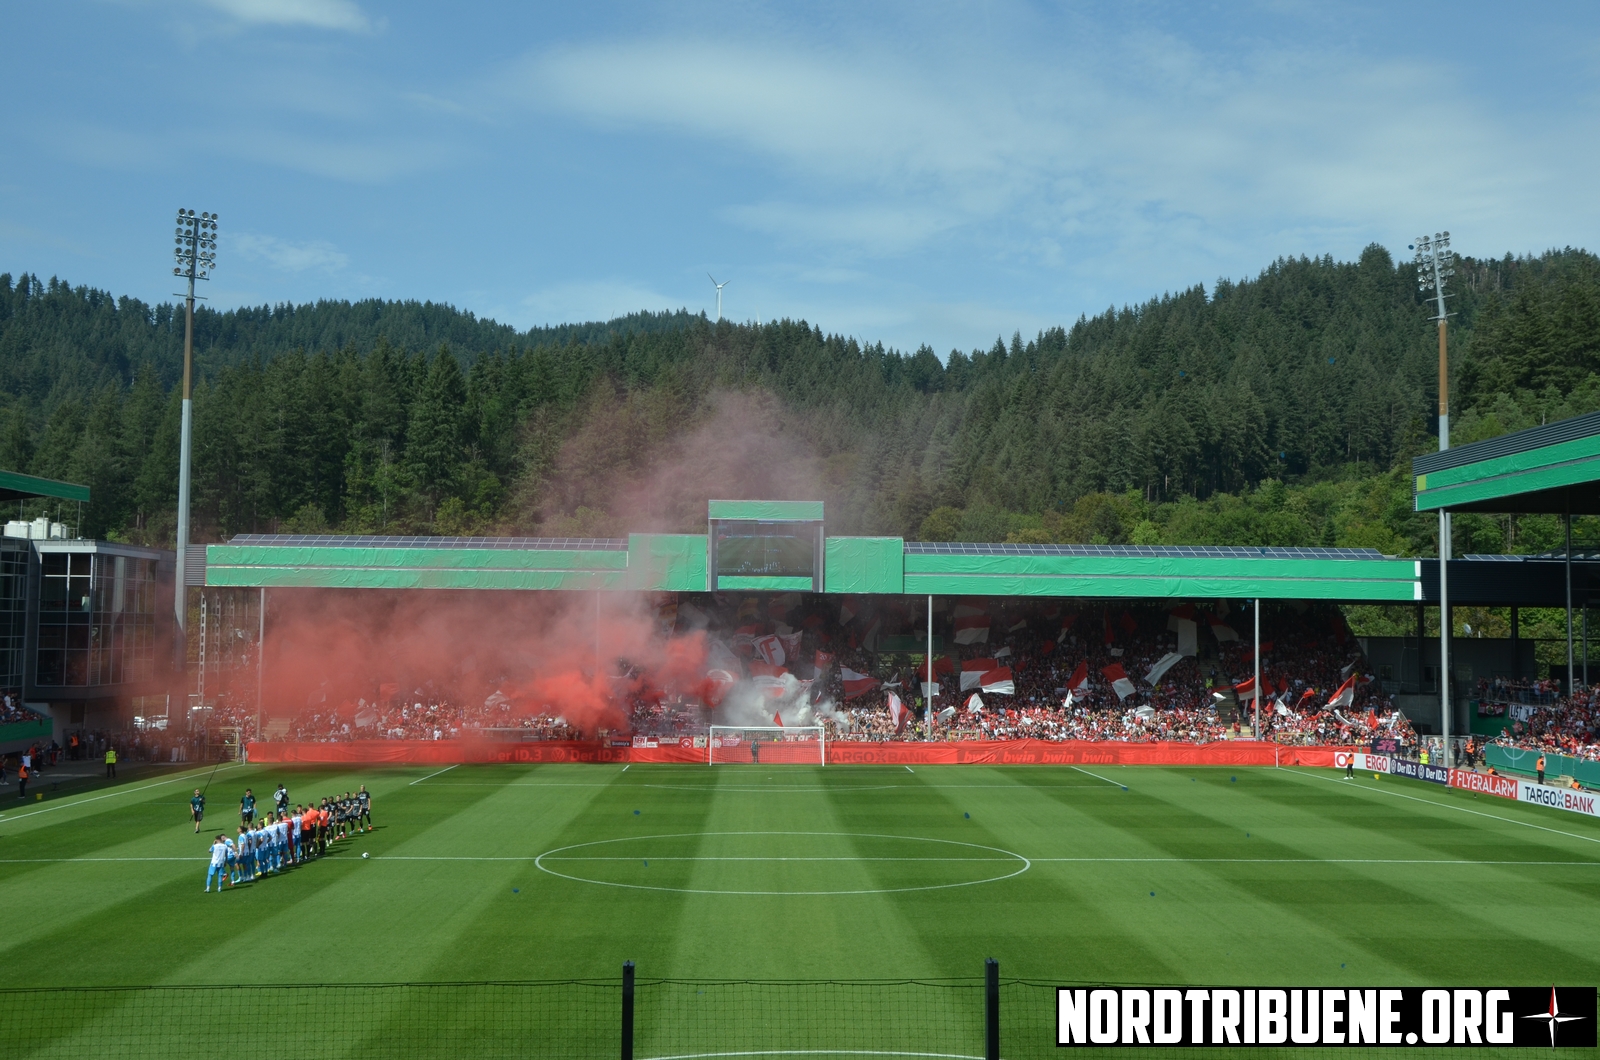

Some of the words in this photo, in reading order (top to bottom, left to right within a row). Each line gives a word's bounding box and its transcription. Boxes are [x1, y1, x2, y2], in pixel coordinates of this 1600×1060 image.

[515, 749, 542, 761] ID.3
[570, 749, 594, 761] Der
[597, 749, 625, 761] ID.3
[1003, 751, 1035, 763] bwin
[1042, 751, 1075, 763] bwin
[1081, 752, 1113, 763] bwin
[1365, 755, 1388, 772] ERGO
[1397, 762, 1406, 774] Der
[1406, 763, 1417, 776] ID.3
[1425, 768, 1435, 780] Der
[1435, 769, 1447, 782] ID.3
[1457, 771, 1516, 798] FLYERALARM
